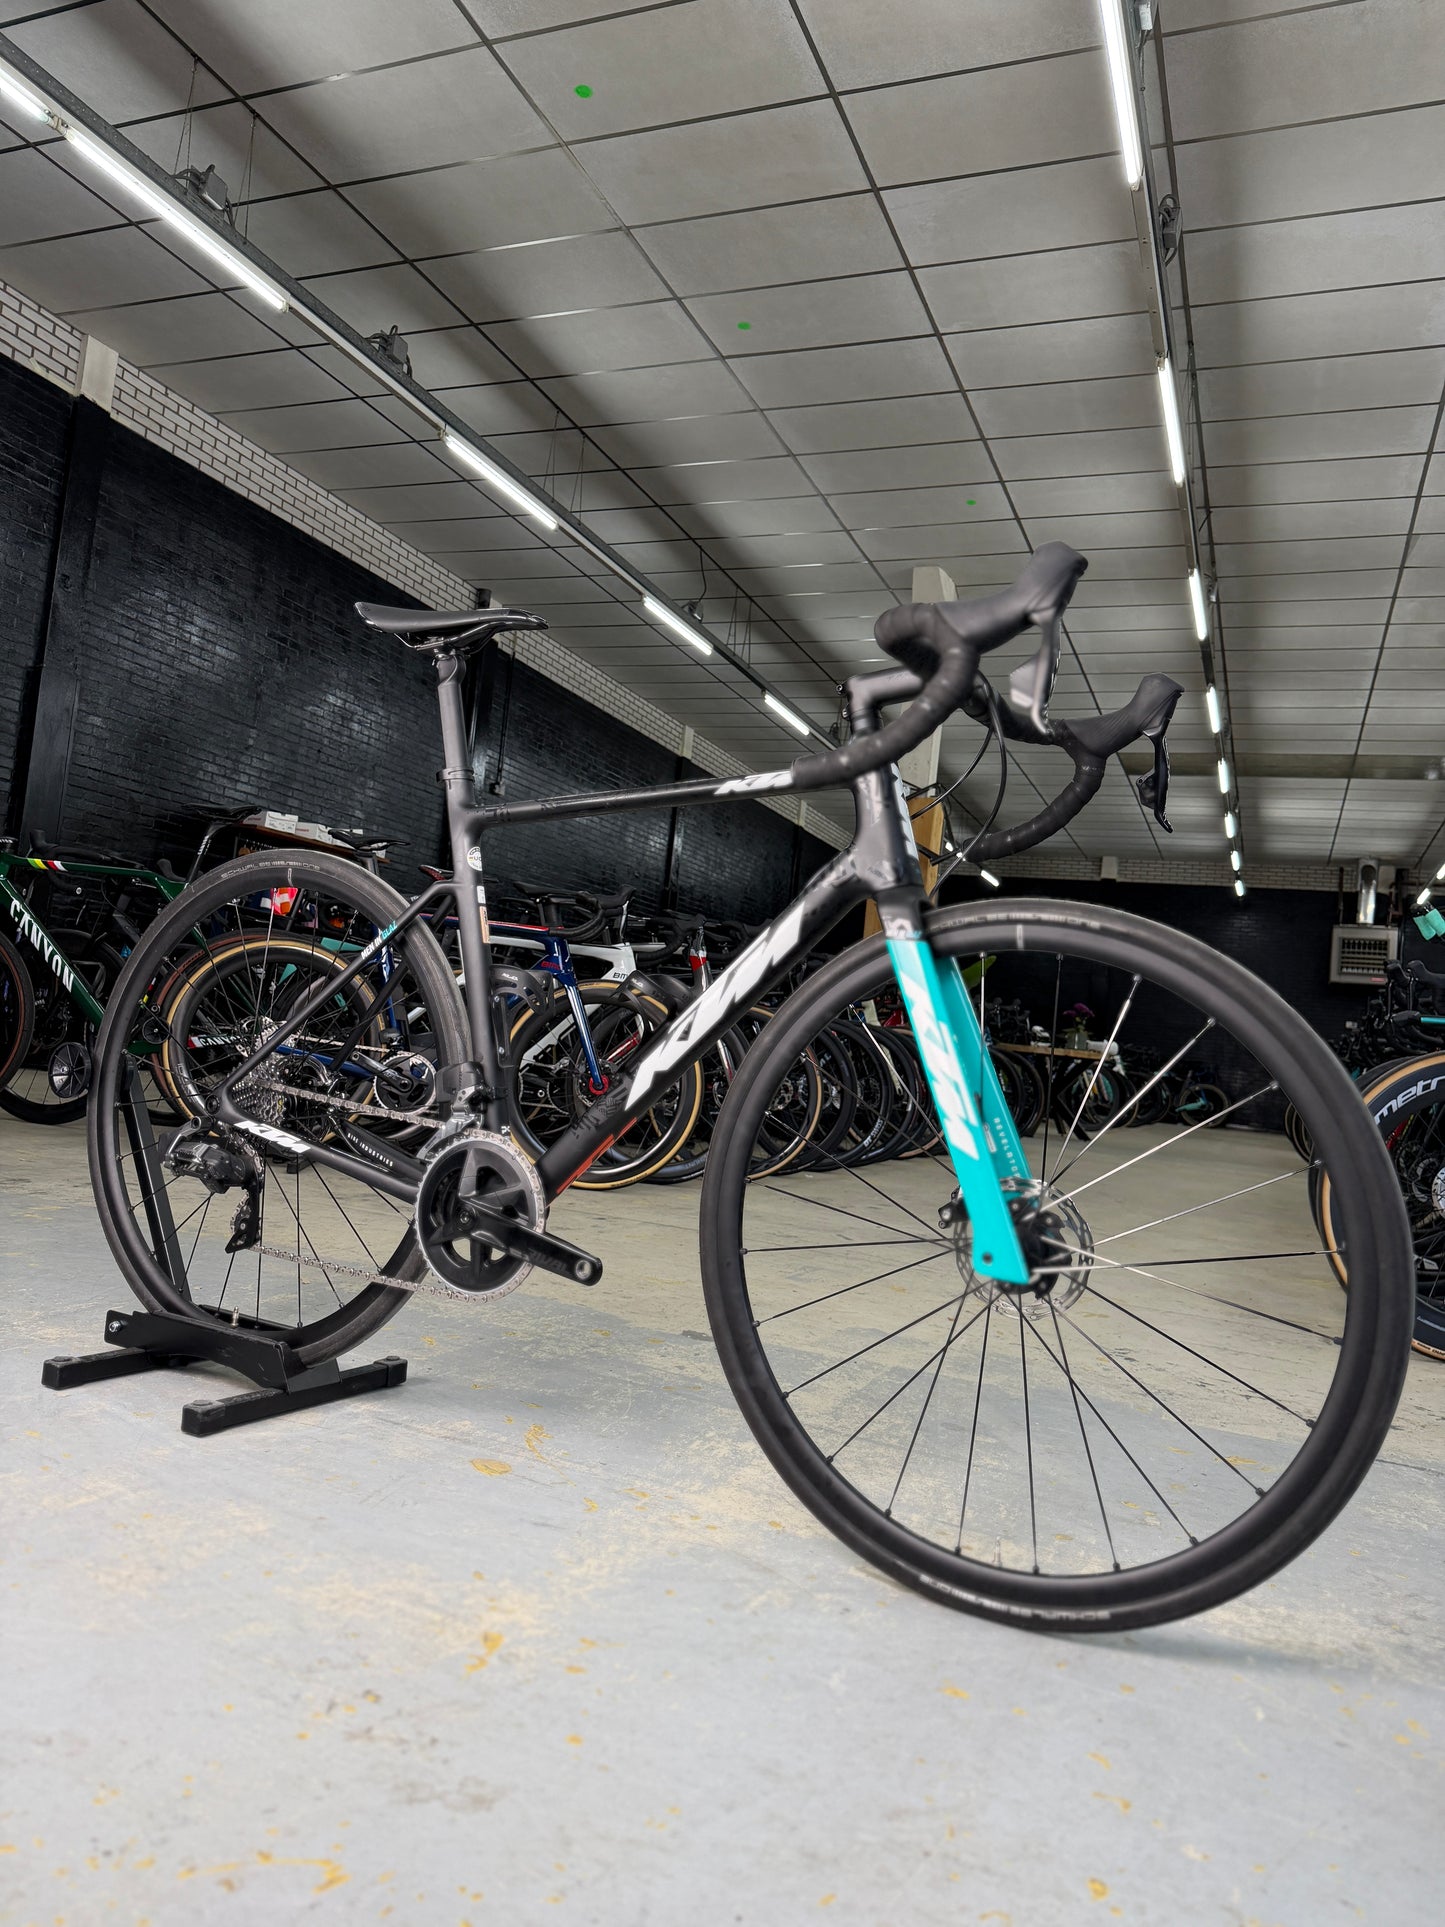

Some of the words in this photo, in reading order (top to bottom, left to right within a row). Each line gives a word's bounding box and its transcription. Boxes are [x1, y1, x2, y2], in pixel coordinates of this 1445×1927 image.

[9, 899, 75, 993] CANYON
[360, 941, 375, 960] MEN
[624, 900, 806, 1113] KTM
[900, 970, 980, 1162] KTM
[233, 1120, 312, 1153] KTM
[359, 1138, 394, 1168] INDUSTRIES
